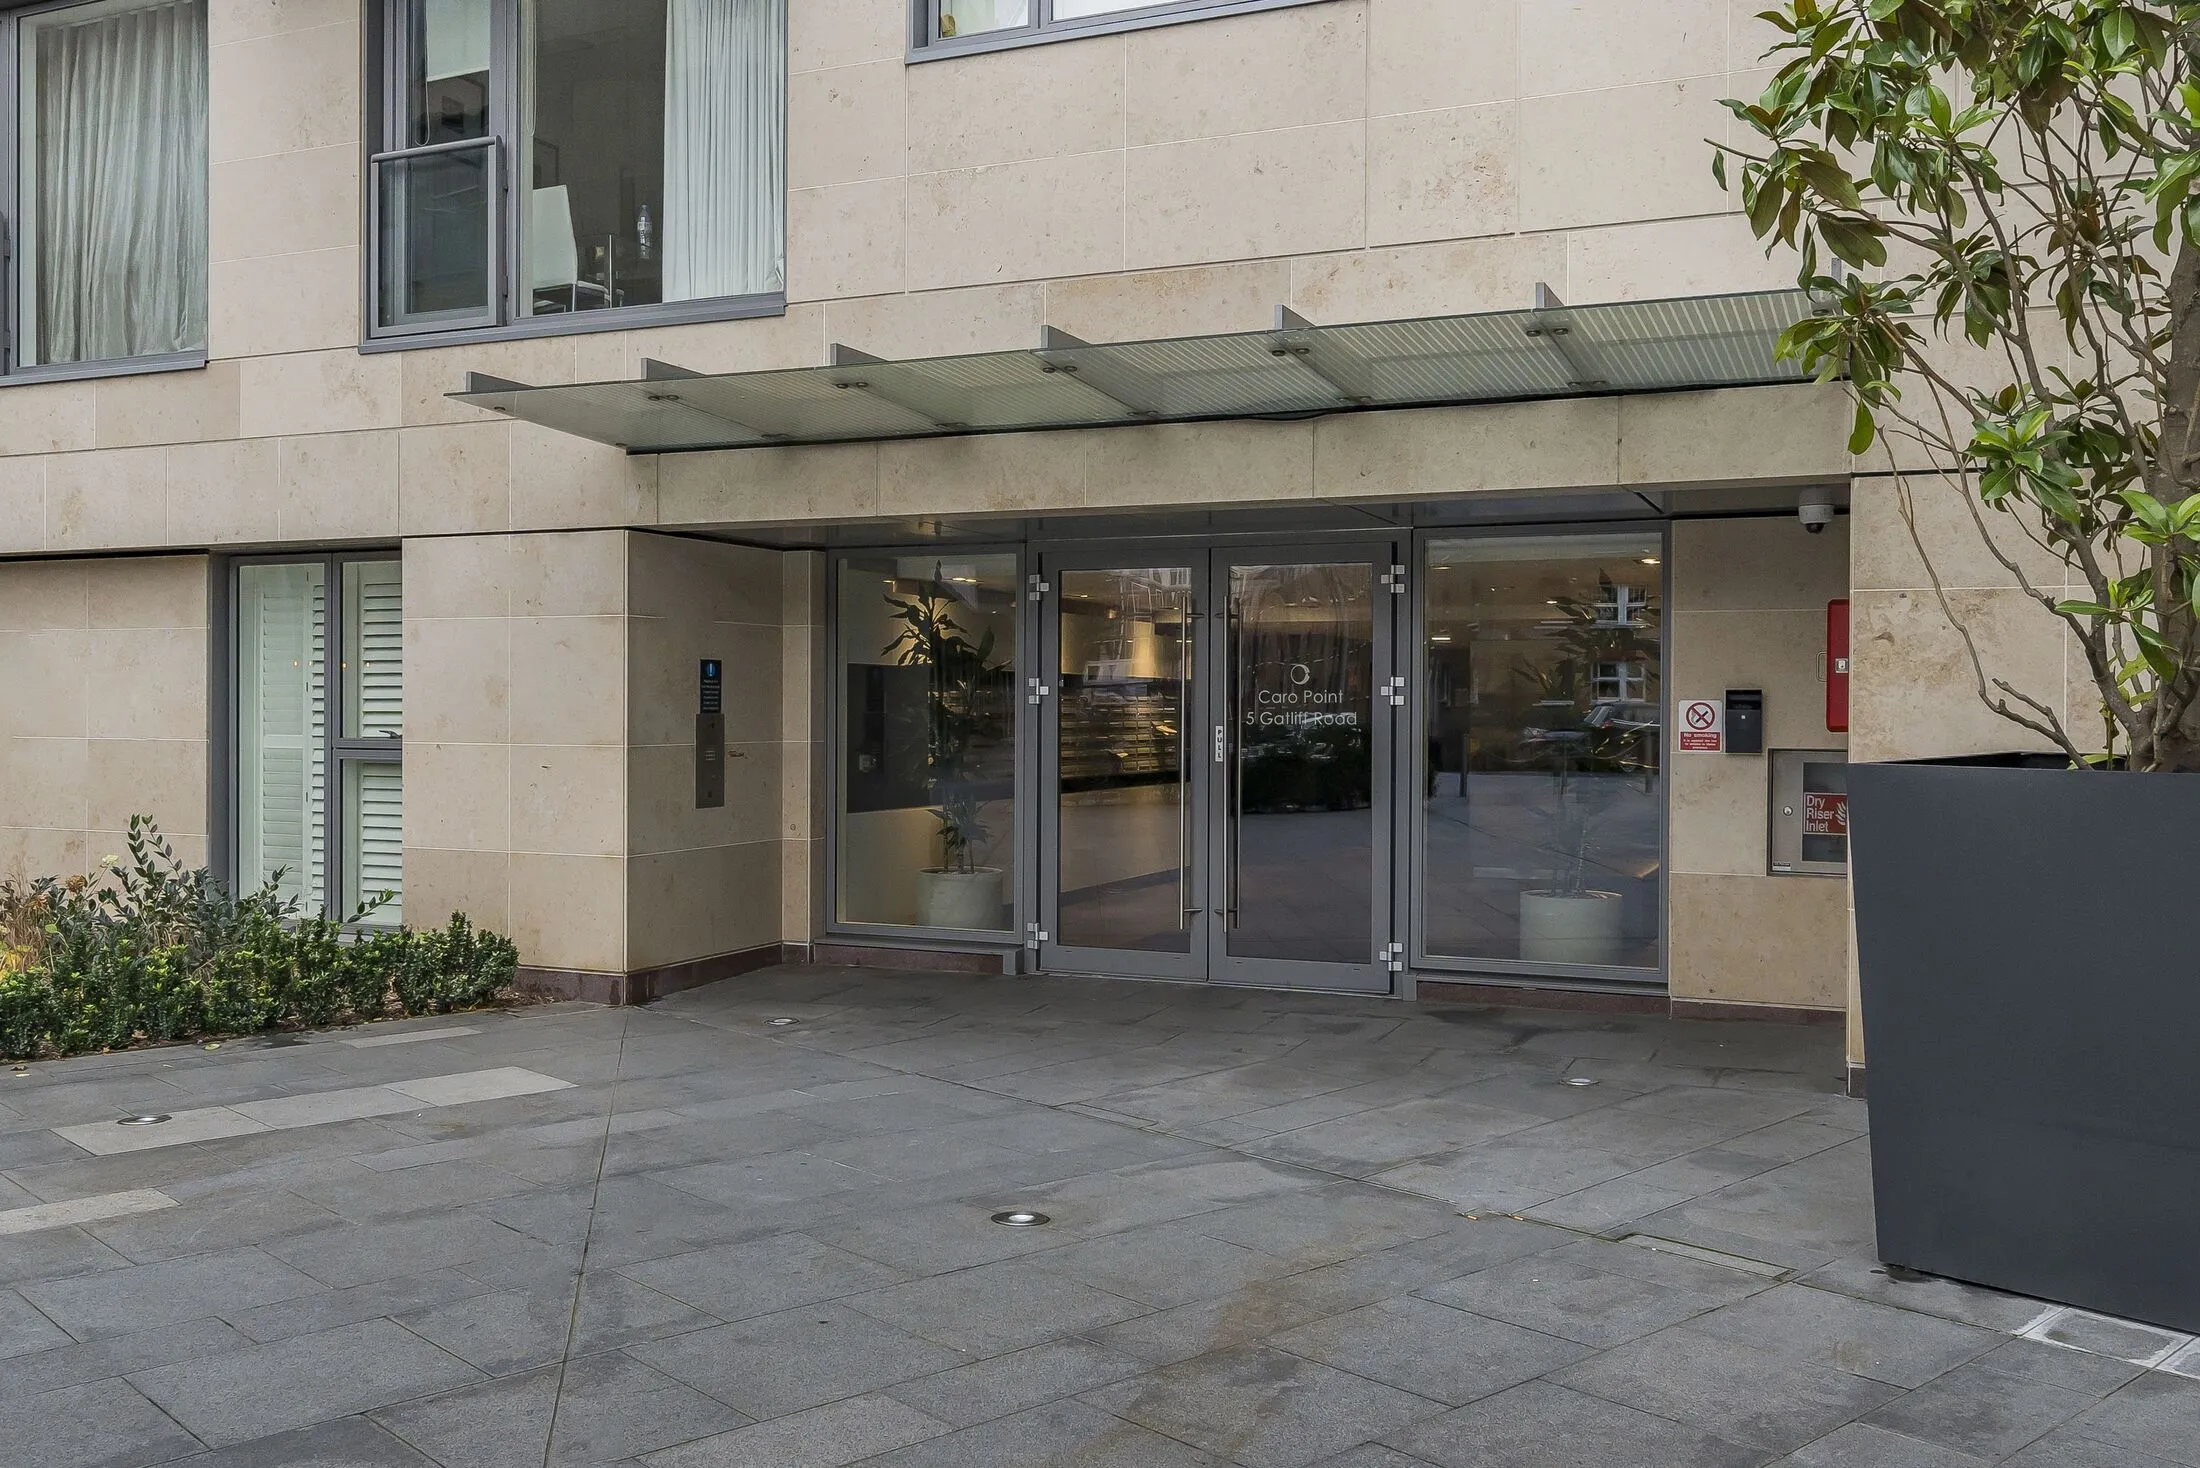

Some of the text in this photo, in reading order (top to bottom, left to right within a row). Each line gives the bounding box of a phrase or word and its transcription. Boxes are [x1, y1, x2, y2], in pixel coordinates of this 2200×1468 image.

[1258, 690, 1344, 704] Caro Point
[1246, 711, 1357, 725] 5 Gatliff Road
[1806, 794, 1826, 810] Dry
[1806, 808, 1835, 820] Riser
[1805, 820, 1829, 832] Inlet
